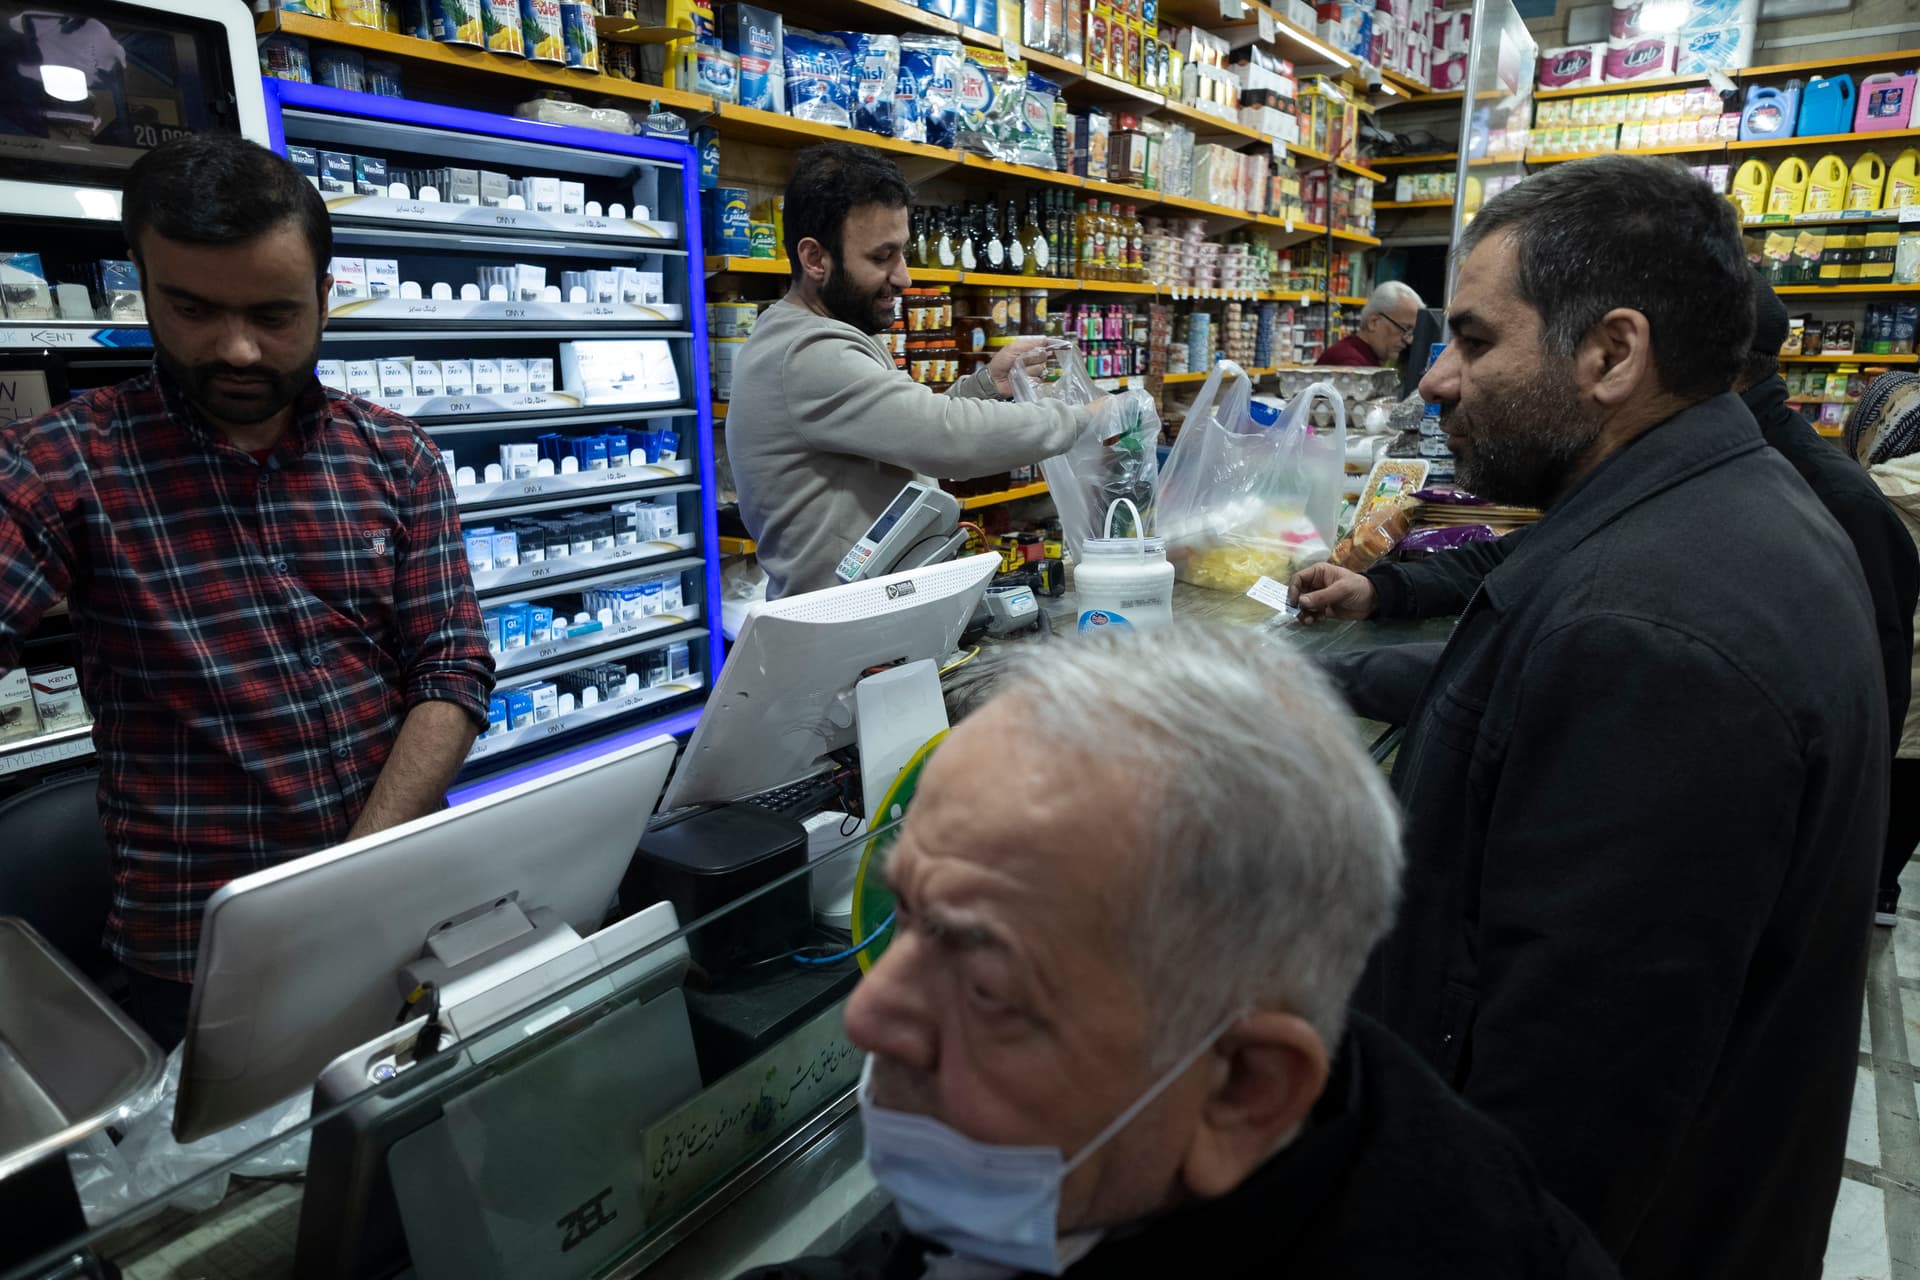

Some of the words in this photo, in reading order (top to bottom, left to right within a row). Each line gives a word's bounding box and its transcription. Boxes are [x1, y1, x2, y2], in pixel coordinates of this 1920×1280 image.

[328, 159, 351, 170] Winston
[363, 163, 385, 175] Winston
[106, 265, 133, 278] KENT
[31, 330, 73, 347] KENT
[48, 673, 73, 684] KENT
